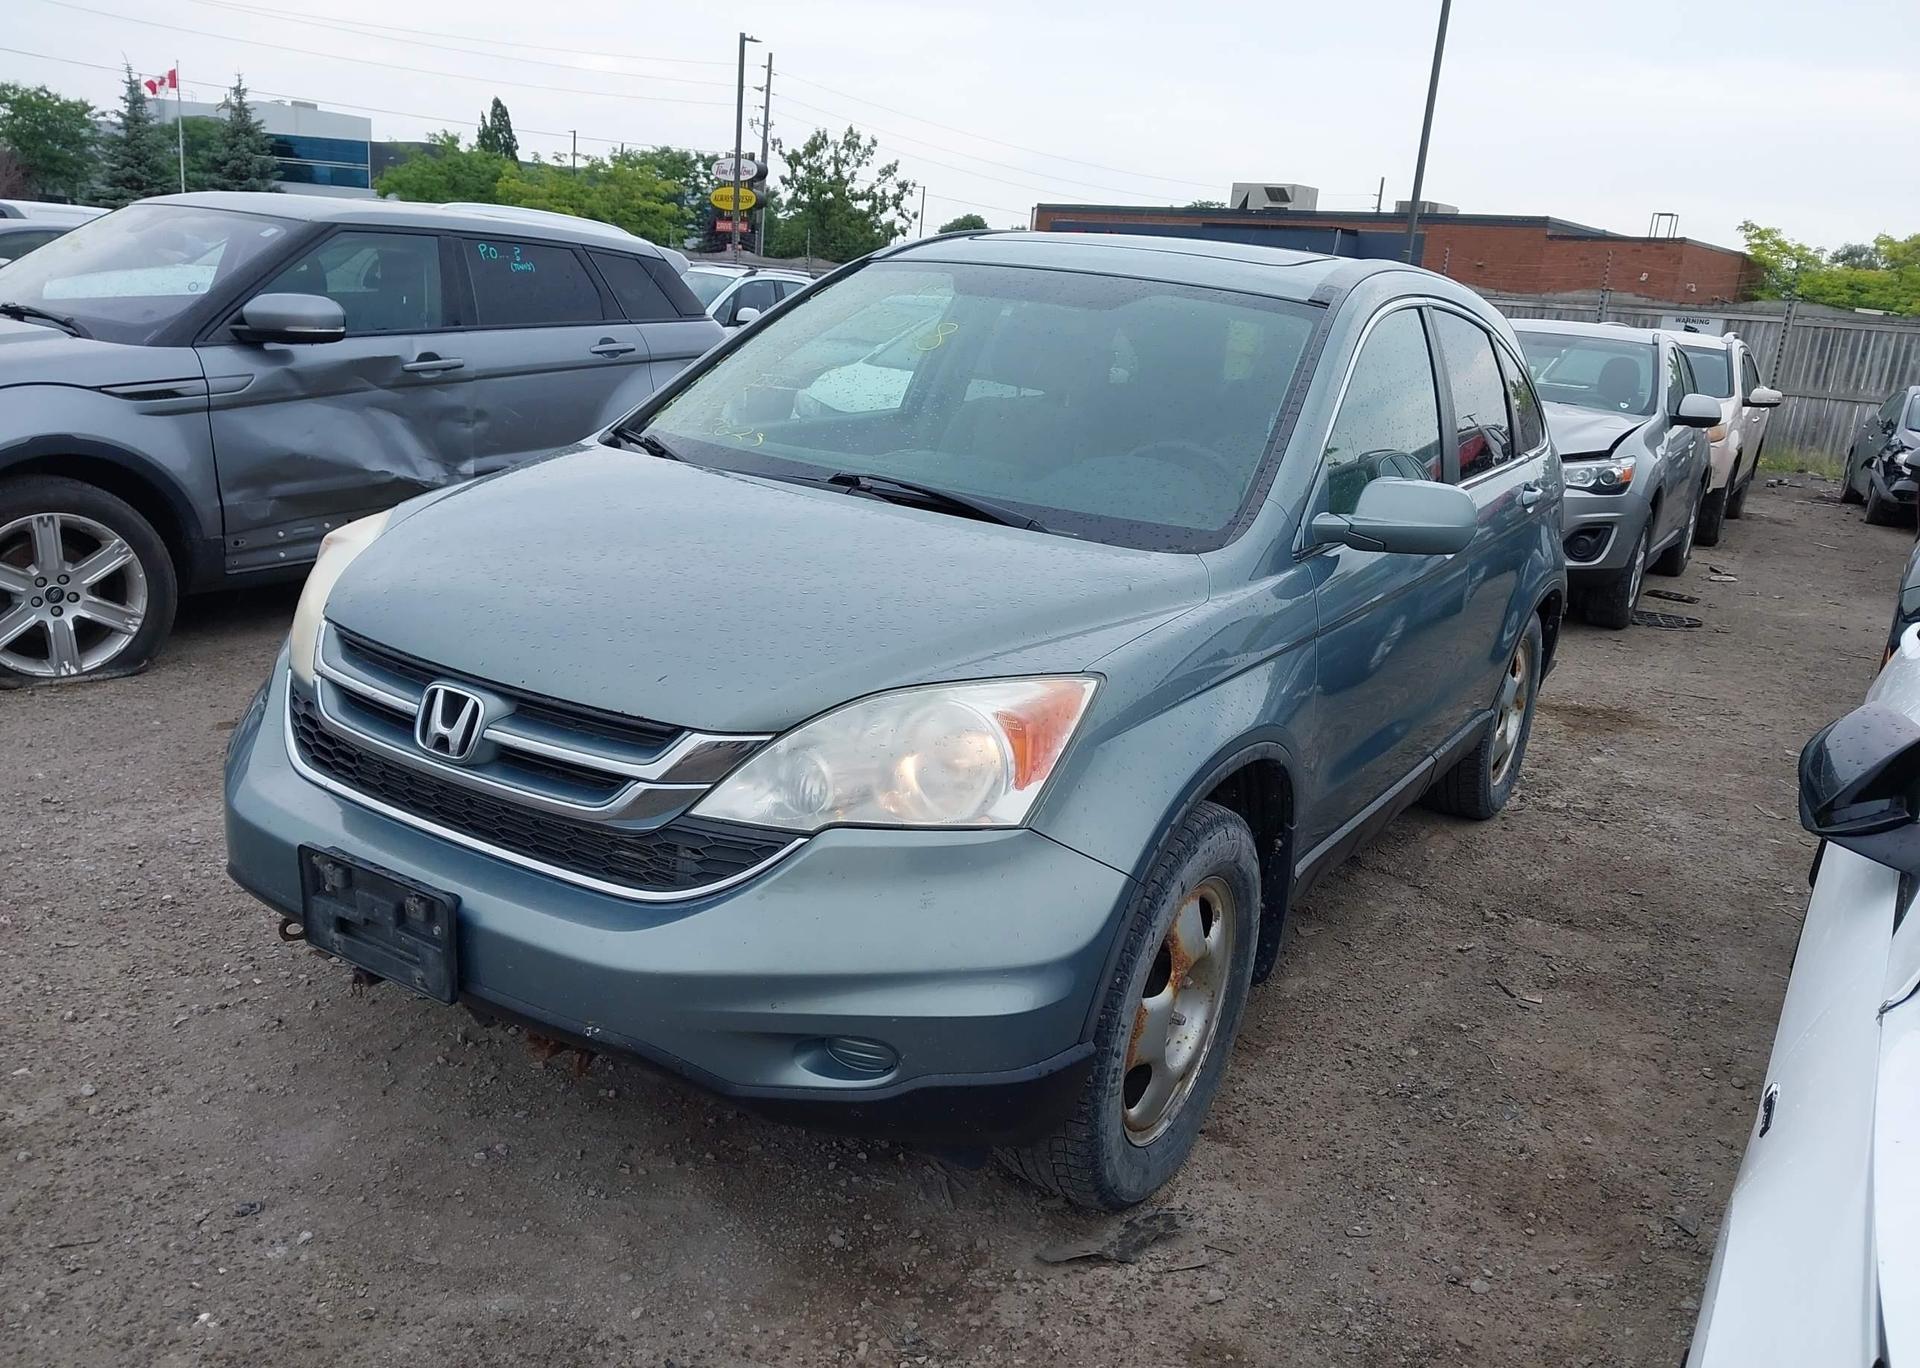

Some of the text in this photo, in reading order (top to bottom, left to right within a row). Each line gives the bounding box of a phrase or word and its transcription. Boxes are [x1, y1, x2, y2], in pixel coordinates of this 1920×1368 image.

[715, 162, 754, 177] Tim Htons
[1675, 316, 1710, 325] WARNING
